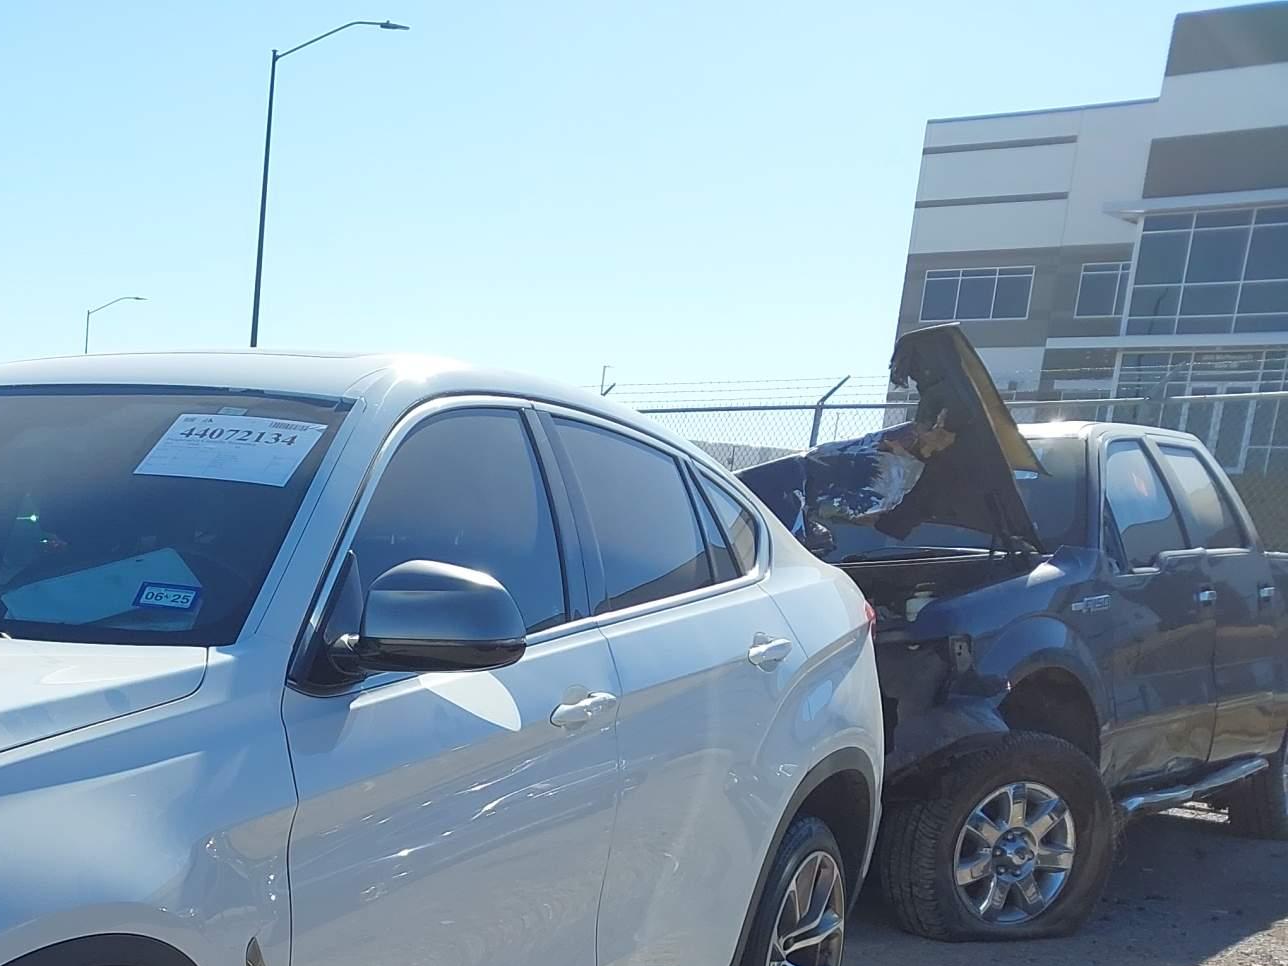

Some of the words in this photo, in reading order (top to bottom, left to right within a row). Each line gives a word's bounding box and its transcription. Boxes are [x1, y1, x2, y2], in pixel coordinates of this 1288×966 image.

[179, 426, 298, 446] 44072134
[144, 591, 164, 602] 06
[171, 594, 191, 604] 25
